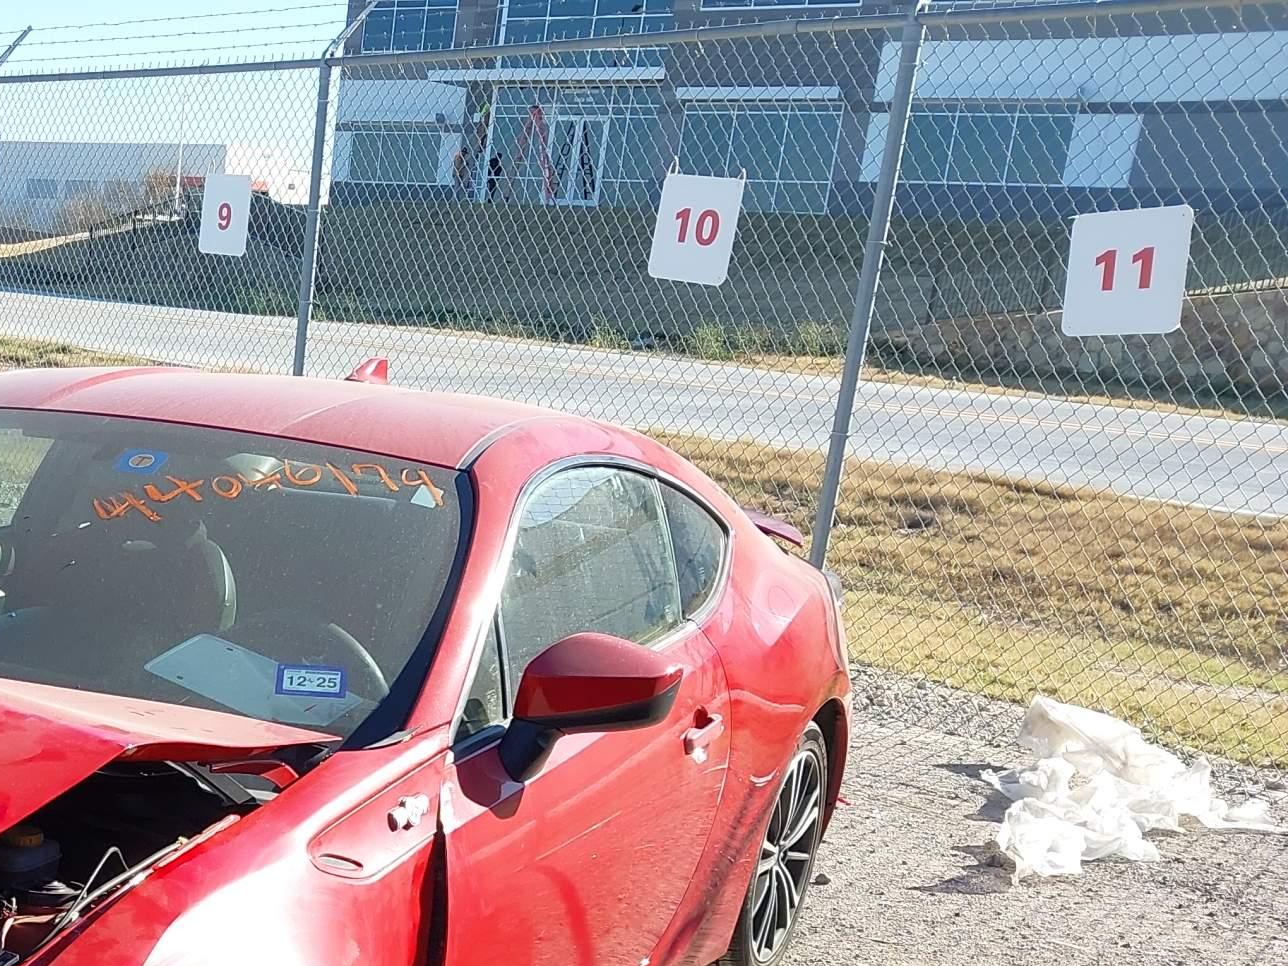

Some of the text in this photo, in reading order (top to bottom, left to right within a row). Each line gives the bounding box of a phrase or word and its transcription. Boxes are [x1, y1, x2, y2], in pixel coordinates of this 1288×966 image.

[216, 201, 232, 231] 9
[676, 208, 720, 247] 10
[1095, 247, 1155, 292] 11
